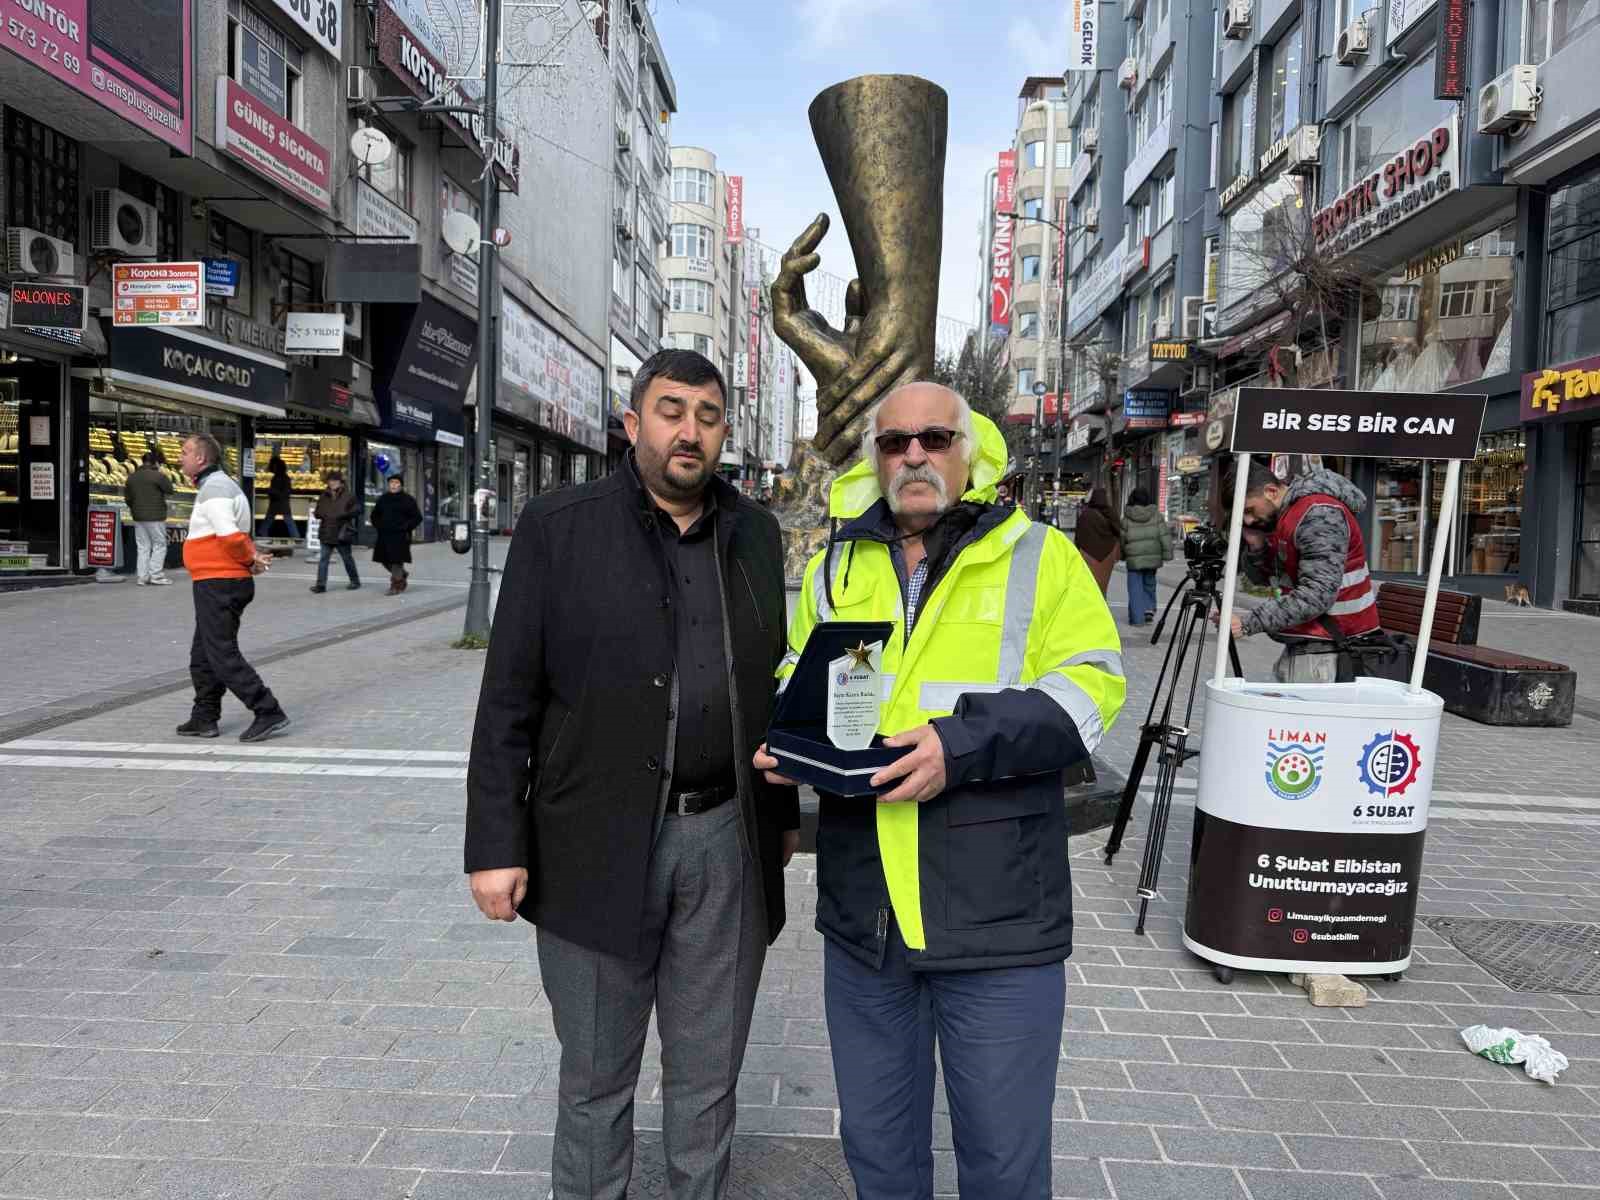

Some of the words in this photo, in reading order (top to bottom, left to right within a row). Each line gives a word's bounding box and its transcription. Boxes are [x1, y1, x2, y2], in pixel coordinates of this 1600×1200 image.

[15, 0, 80, 43] ONTÖR
[8, 17, 36, 48] 573
[42, 37, 59, 62] 72
[63, 51, 80, 74] 69
[1081, 20, 1095, 65] GELDİK
[233, 99, 276, 144] GÜNEŞ
[279, 130, 325, 176] SİGORTA
[1312, 173, 1380, 246] EROTİK
[1383, 127, 1450, 198] SHOP
[130, 268, 168, 279] Корона
[14, 289, 71, 306] SALOONES
[118, 312, 131, 322] ria
[313, 328, 341, 337] YILDIZ
[1152, 343, 1187, 359] TATTOO
[163, 347, 213, 380] KOÇAK
[214, 360, 250, 388] GOLD
[1262, 408, 1301, 431] BİR
[1307, 413, 1351, 433] SES
[1357, 411, 1397, 434] BİR
[1403, 417, 1455, 435] CAN
[1353, 805, 1362, 818] 6
[1257, 854, 1270, 868] 6
[1275, 855, 1329, 873] Şubat
[1334, 858, 1402, 874] Elbistan
[1249, 872, 1409, 896] Unutturmayacağız
